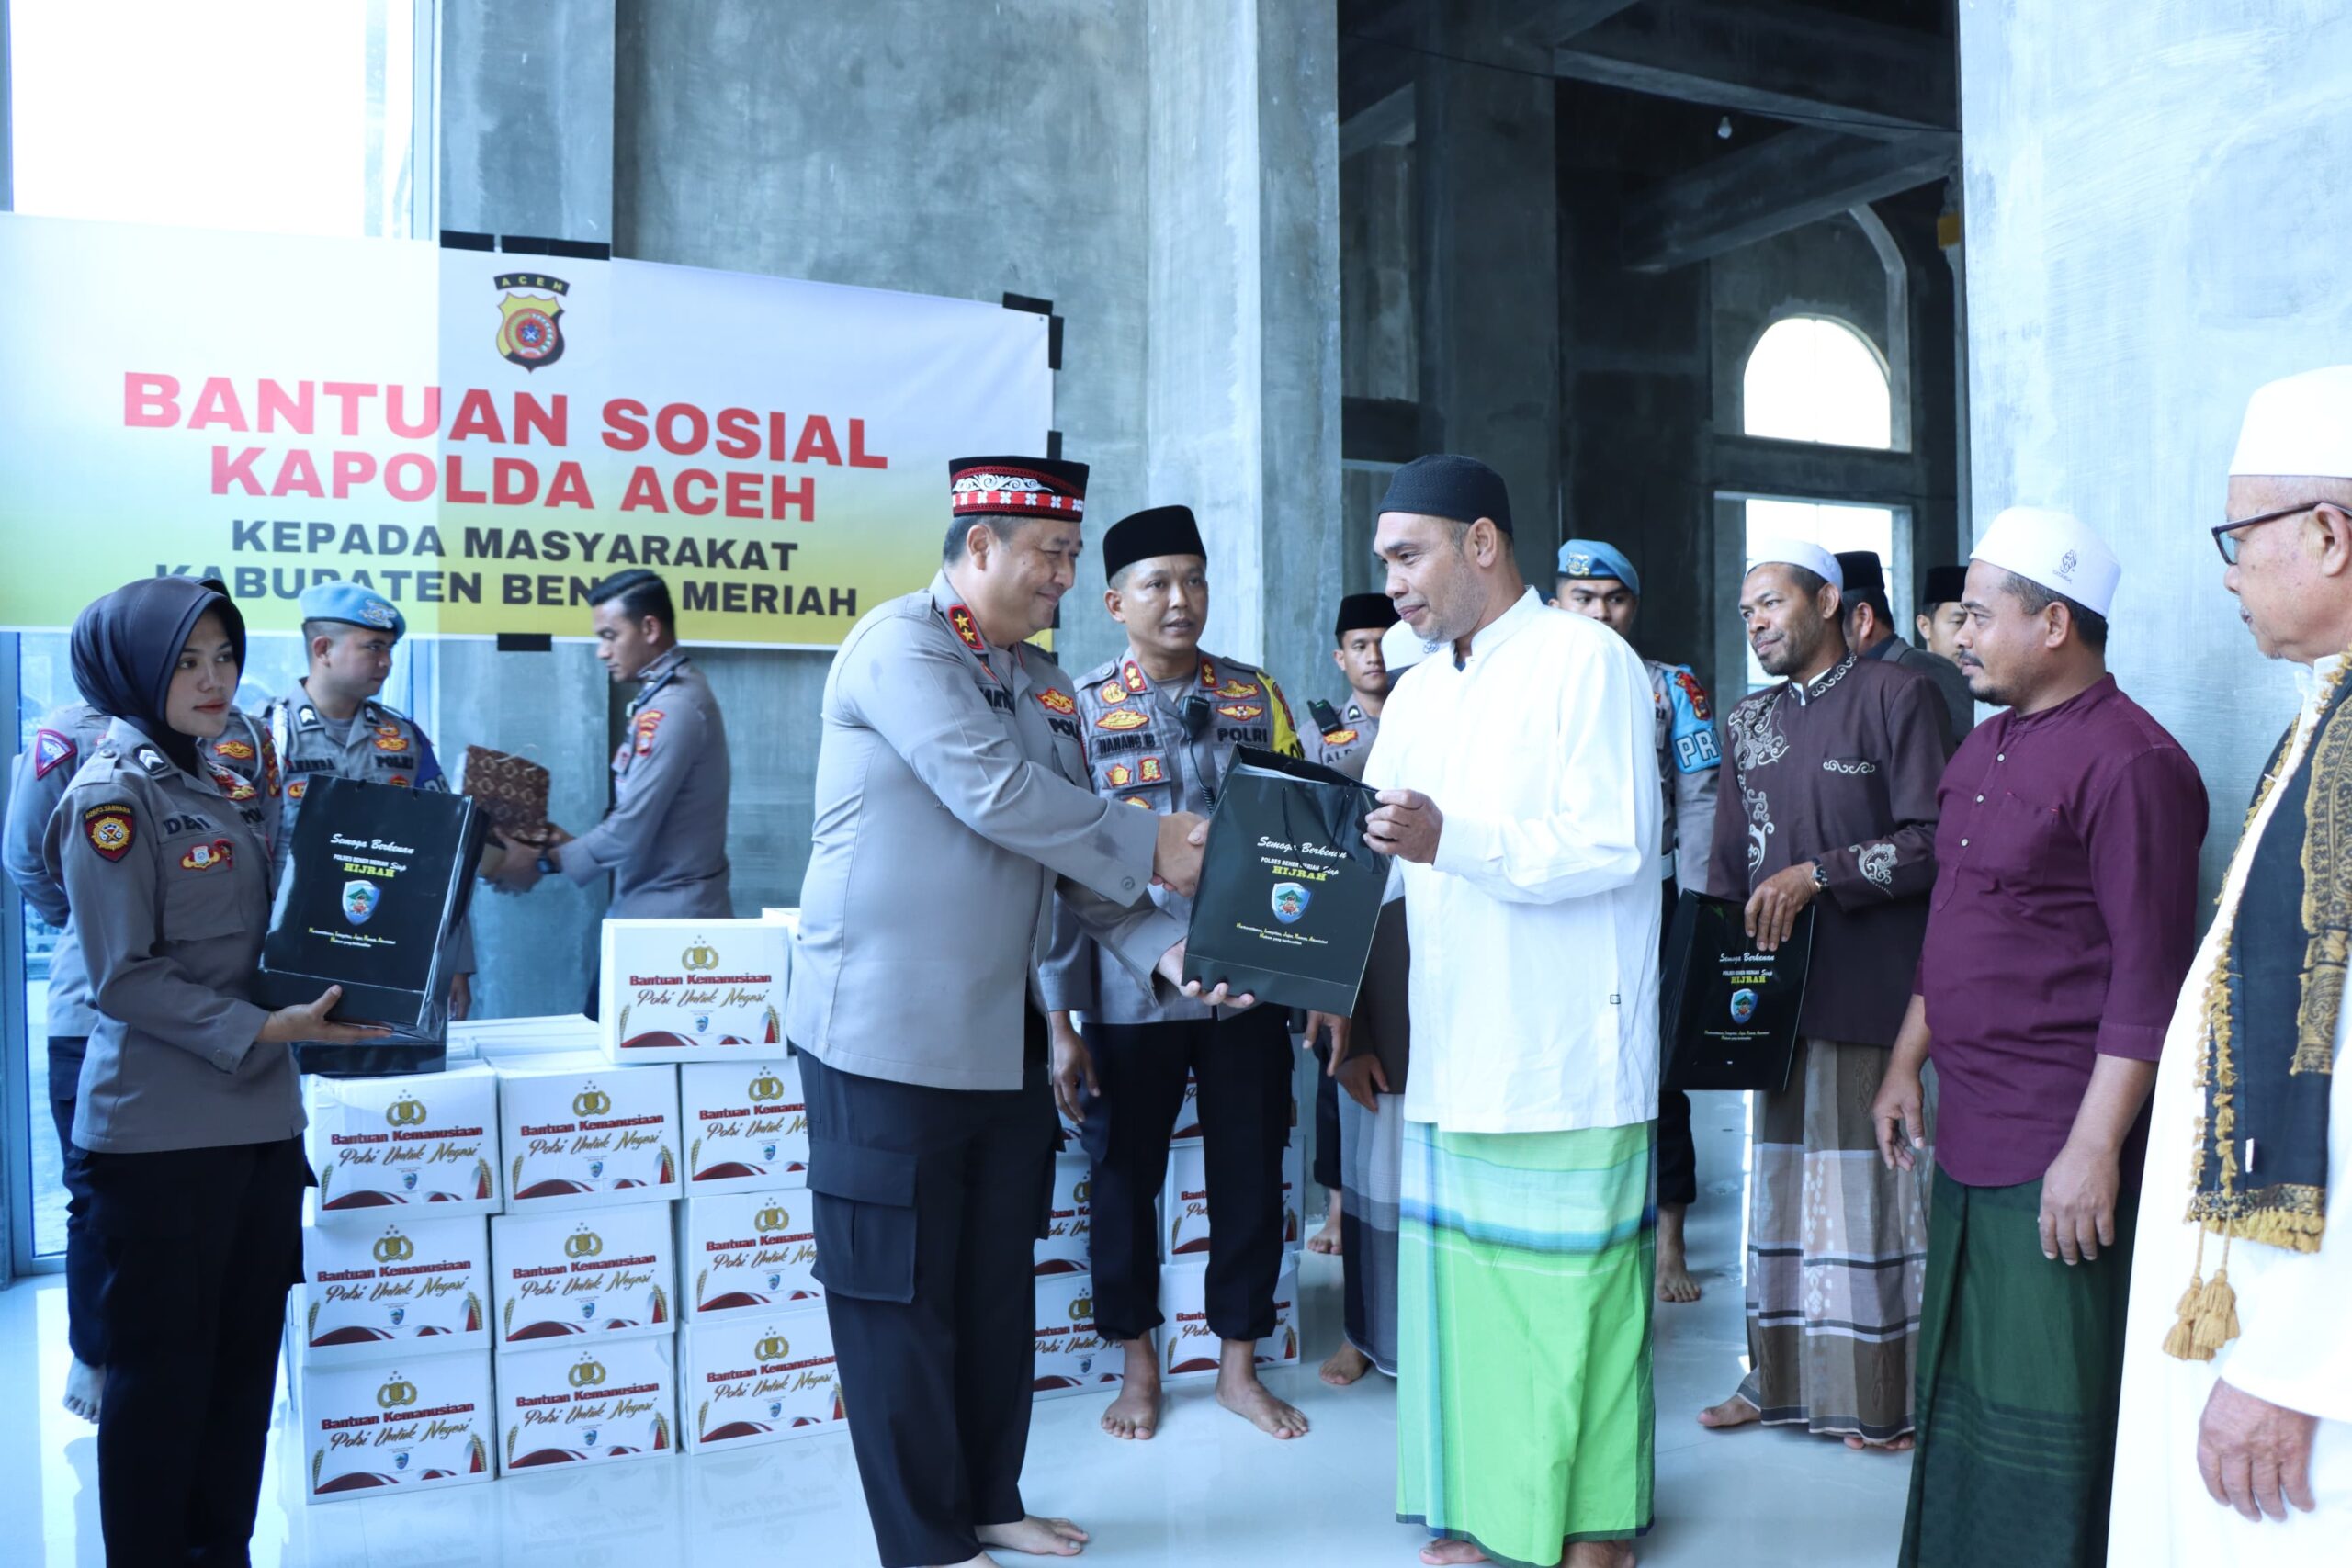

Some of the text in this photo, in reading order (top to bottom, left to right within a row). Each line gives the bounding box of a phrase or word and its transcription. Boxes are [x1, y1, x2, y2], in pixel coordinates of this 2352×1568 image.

[502, 276, 563, 291] ACEH
[123, 371, 888, 469] BANTUAN SOSIAL
[210, 446, 815, 522] KAPOLDA ACEH
[232, 520, 798, 571] KEPADA MASYARAKAT
[502, 572, 601, 606] BEN
[682, 581, 857, 616] MERIAH
[1047, 717, 1080, 742] POL
[1217, 728, 1268, 743] POLRI
[1675, 728, 1723, 769] PR
[374, 754, 413, 770] POLRI
[330, 833, 415, 855] Semoga Berkenan
[343, 862, 396, 878] HIJRAH
[1260, 856, 1281, 866] POLRES
[1281, 859, 1299, 869] BENER
[1272, 865, 1328, 881] HIJRAH
[1743, 952, 1775, 963] Berkenan
[629, 973, 772, 986] Bantuan Kemanusiaan
[1730, 976, 1767, 985] HIJRAH
[637, 988, 675, 1007] Polri
[677, 988, 719, 1008] Untuk
[521, 1114, 664, 1136] Bantuan Kemanusiaan
[699, 1108, 751, 1120] Bantuan
[331, 1126, 483, 1145] Bantuan Kemanusiaan
[707, 1121, 743, 1141] Polri
[745, 1117, 785, 1138] Untuk
[339, 1148, 380, 1167] Polri
[382, 1143, 427, 1166] Untuk
[529, 1138, 568, 1157] Polri
[571, 1133, 612, 1155] Untuk
[1181, 1190, 1207, 1201] Bant
[706, 1232, 814, 1251] Bantuan Kemanus
[317, 1259, 471, 1282] Bantuan Kemanusiaan
[513, 1254, 657, 1280] Bantuan Kemanusiaan
[713, 1251, 750, 1271] Polri
[751, 1247, 790, 1269] Untuk
[326, 1283, 368, 1304] Polri
[369, 1278, 414, 1302] Untuk
[521, 1279, 560, 1300] Polri
[562, 1273, 604, 1296] Untuk
[707, 1369, 757, 1382] Bantuan
[516, 1383, 660, 1407] Bantuan Kemanusiaan
[714, 1382, 751, 1403] Polri
[752, 1374, 790, 1397] Untuk
[322, 1403, 475, 1430] Bantuan Kemanusiaan
[525, 1407, 563, 1427] Polri
[565, 1402, 607, 1425] Untuk
[331, 1429, 372, 1451] Polri
[374, 1423, 418, 1448] Untuk
